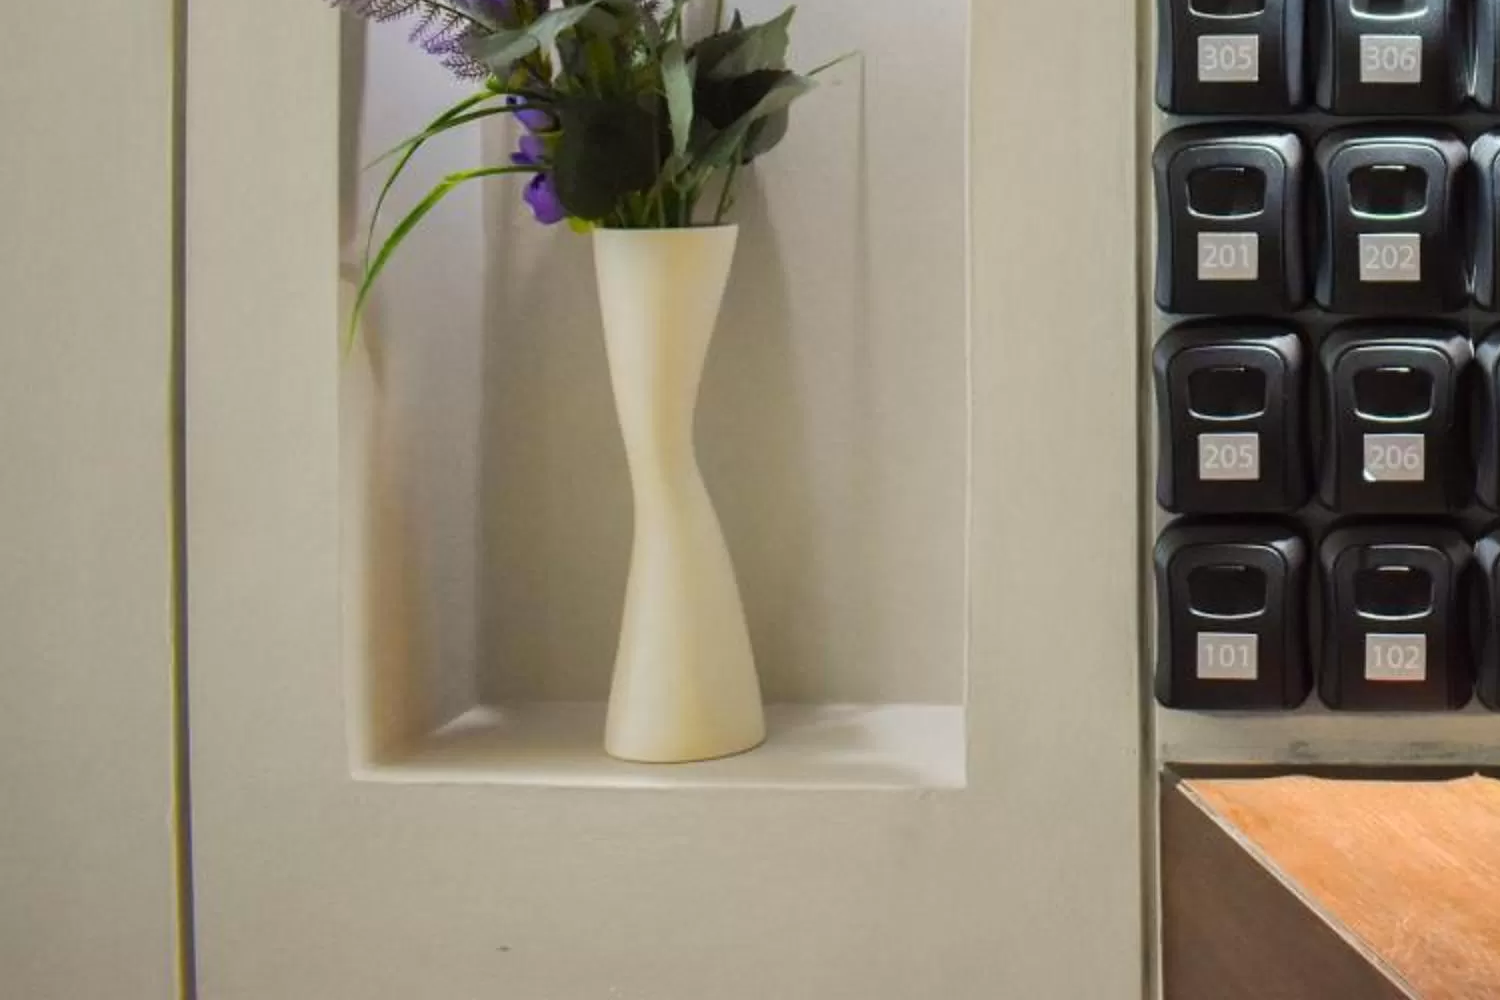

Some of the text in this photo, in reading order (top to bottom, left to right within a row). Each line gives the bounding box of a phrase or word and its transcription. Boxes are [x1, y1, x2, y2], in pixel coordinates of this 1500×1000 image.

[1203, 44, 1251, 71] 305
[1365, 45, 1416, 71] 306
[1203, 243, 1249, 268] 201
[1366, 245, 1415, 270] 202
[1204, 443, 1253, 469] 205
[1370, 444, 1420, 470] 206
[1205, 643, 1249, 668] 101
[1373, 645, 1421, 670] 102
